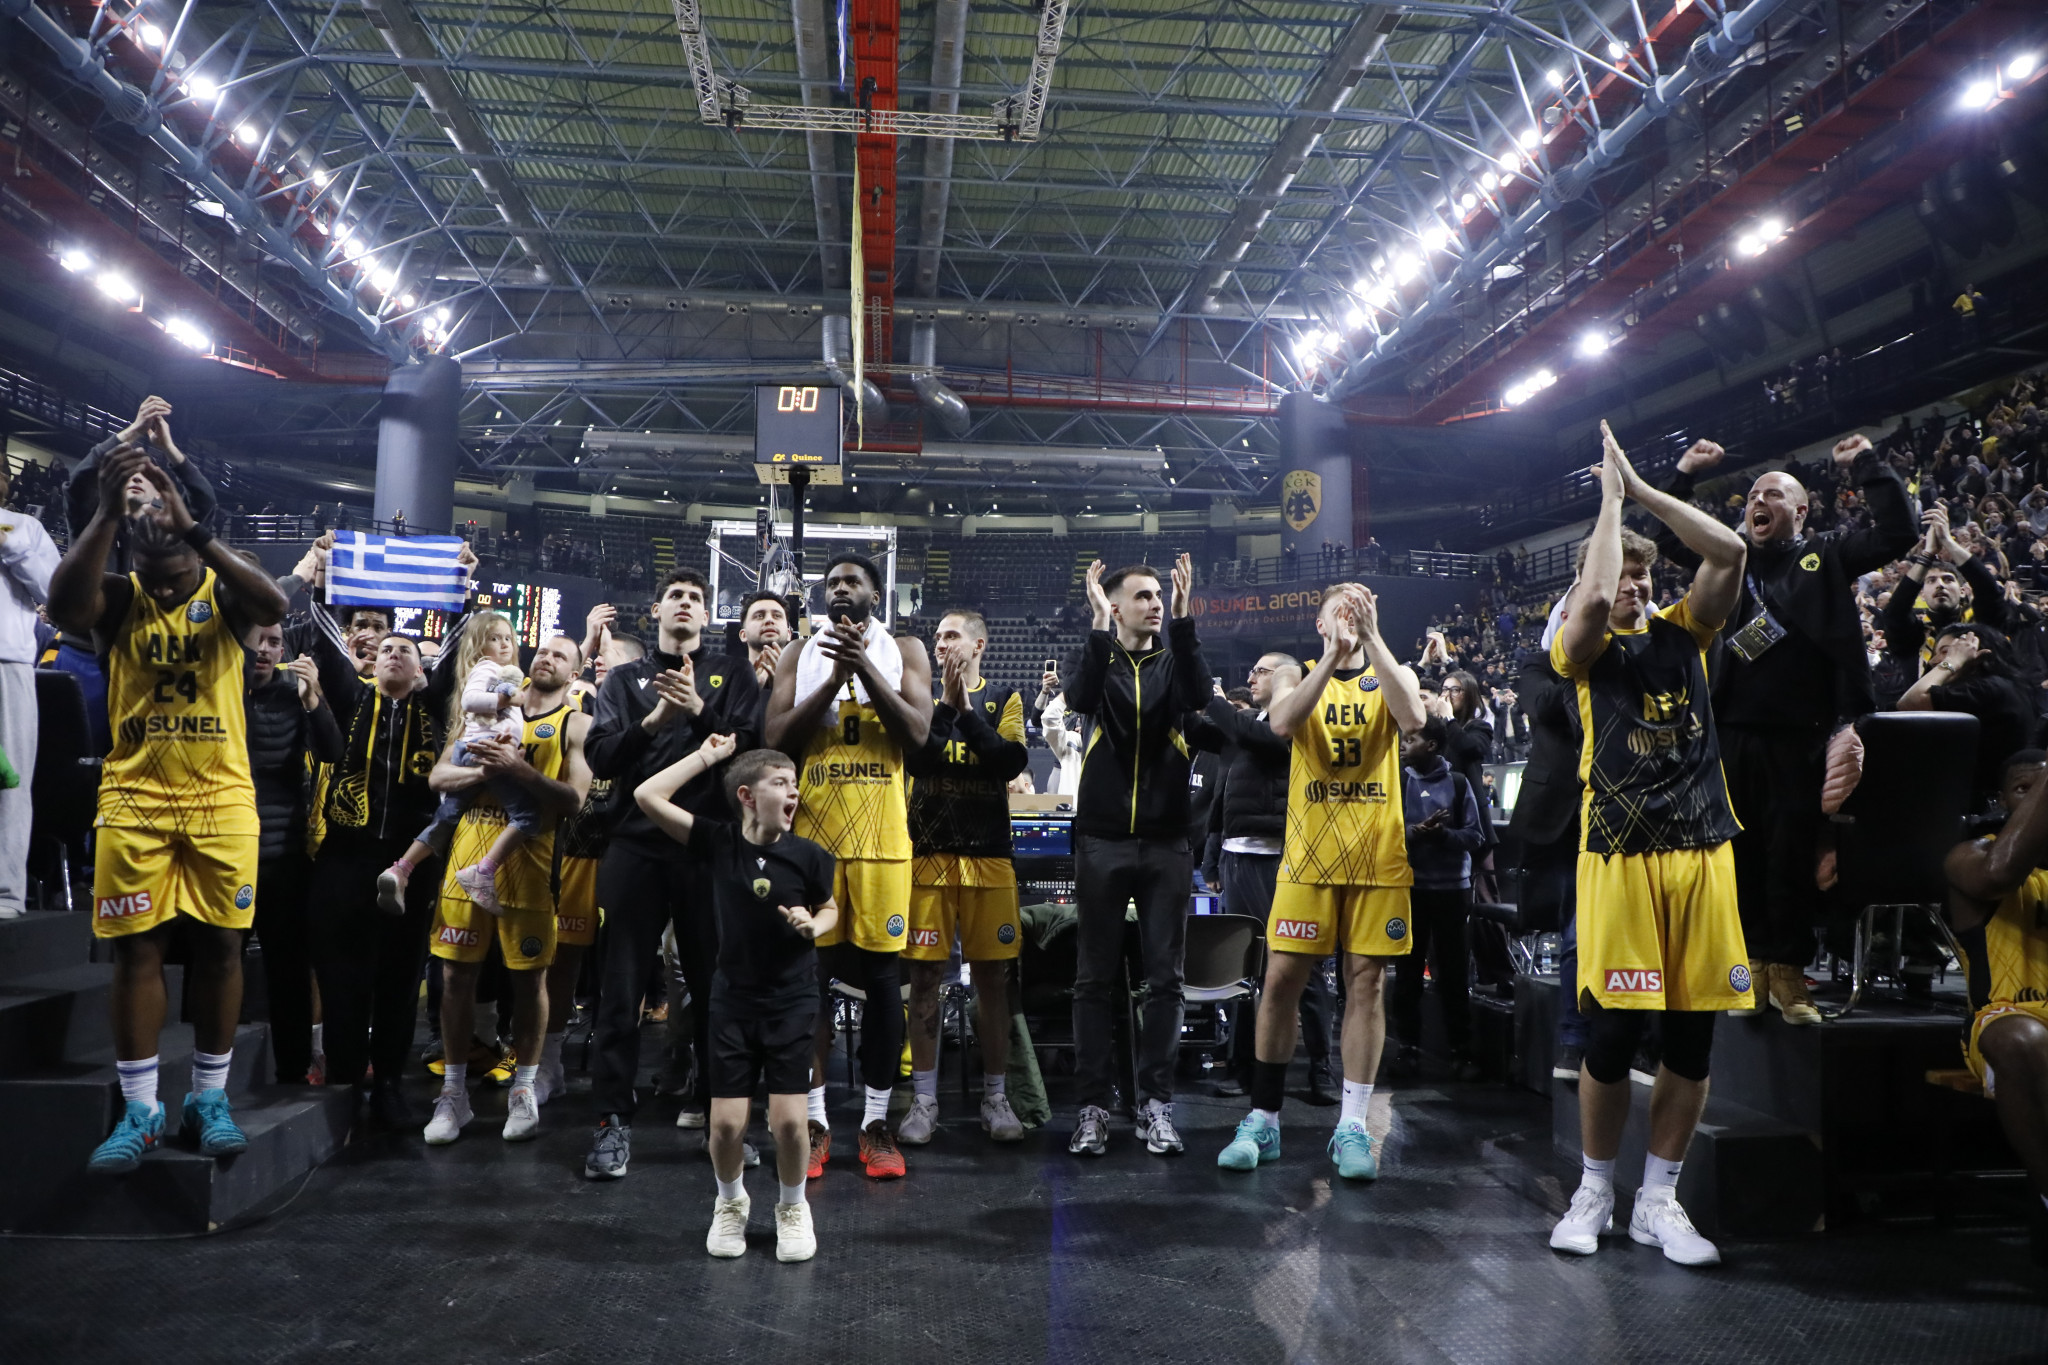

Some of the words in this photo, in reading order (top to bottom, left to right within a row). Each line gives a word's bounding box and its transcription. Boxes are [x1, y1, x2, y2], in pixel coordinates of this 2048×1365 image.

[791, 454, 823, 462] Quince
[1210, 596, 1266, 614] SUNEL
[1269, 590, 1321, 610] arena
[148, 633, 202, 664] AEK
[154, 669, 198, 704] 24
[147, 715, 227, 734] SUNEL
[1325, 703, 1368, 726] AEK
[844, 715, 860, 746] 8
[1331, 737, 1361, 768] 33
[829, 762, 892, 778] SUNEL
[1329, 782, 1387, 797] SUNEL
[99, 892, 151, 918] AVIS
[440, 926, 478, 945] AVIS
[1276, 920, 1318, 939] AVIS
[1607, 971, 1661, 990] AVIS
